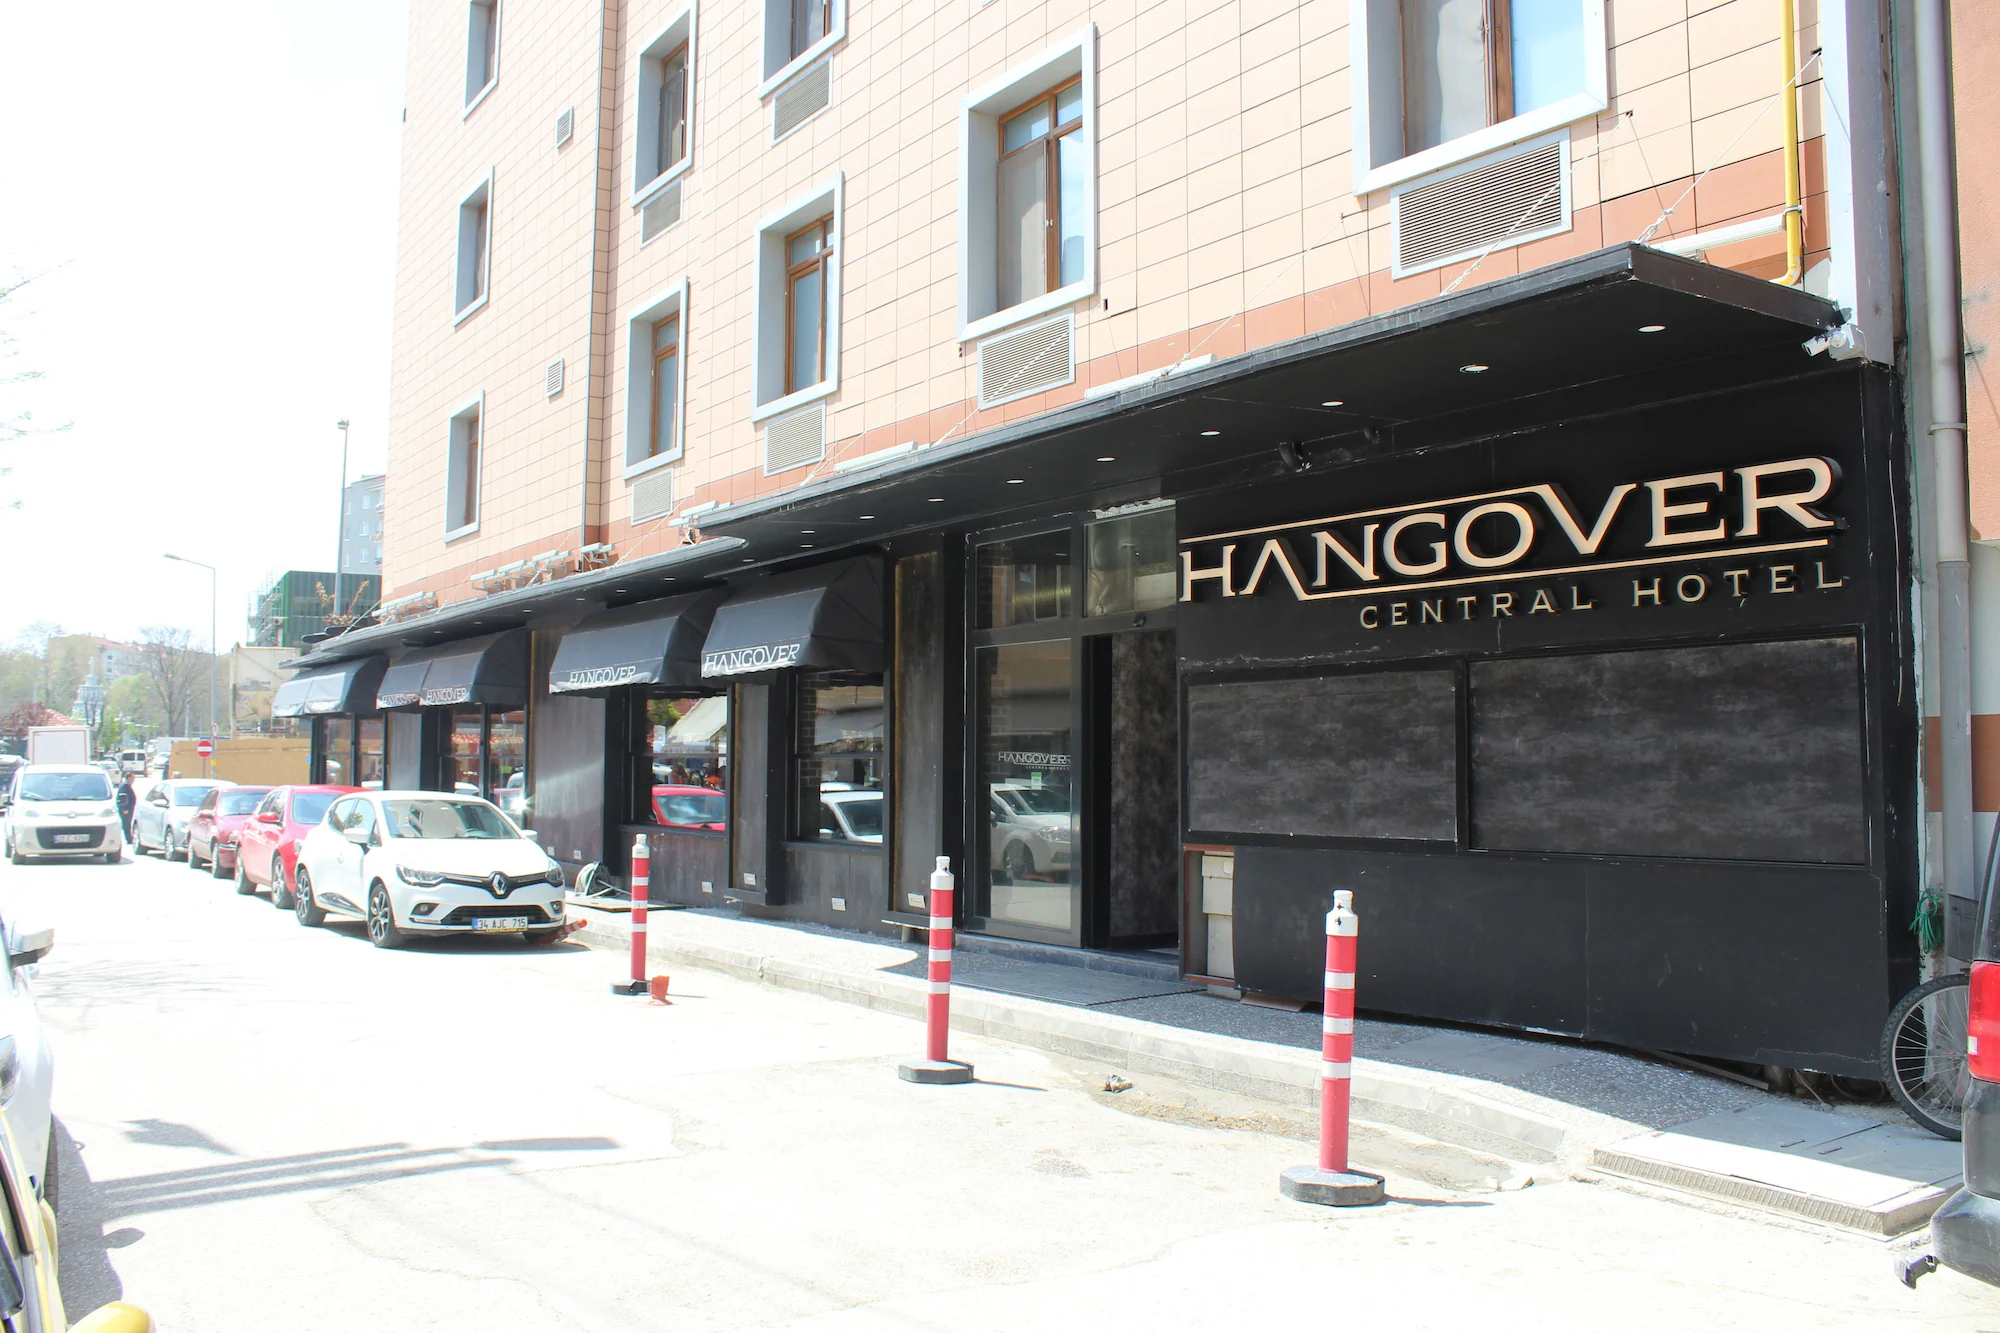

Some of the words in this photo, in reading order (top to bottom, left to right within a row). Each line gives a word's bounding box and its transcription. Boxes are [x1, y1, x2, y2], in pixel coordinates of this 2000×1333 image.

[1179, 457, 1835, 602] HANGOVER
[1360, 585, 1593, 629] CENTRAL
[1632, 561, 1843, 607] HOTEL
[703, 644, 800, 672] HANGOVER
[567, 666, 636, 686] HANGOVER
[998, 751, 1068, 766] HANGOVER
[478, 920, 488, 929] 34
[492, 919, 507, 929] AJC
[512, 918, 526, 928] 715
